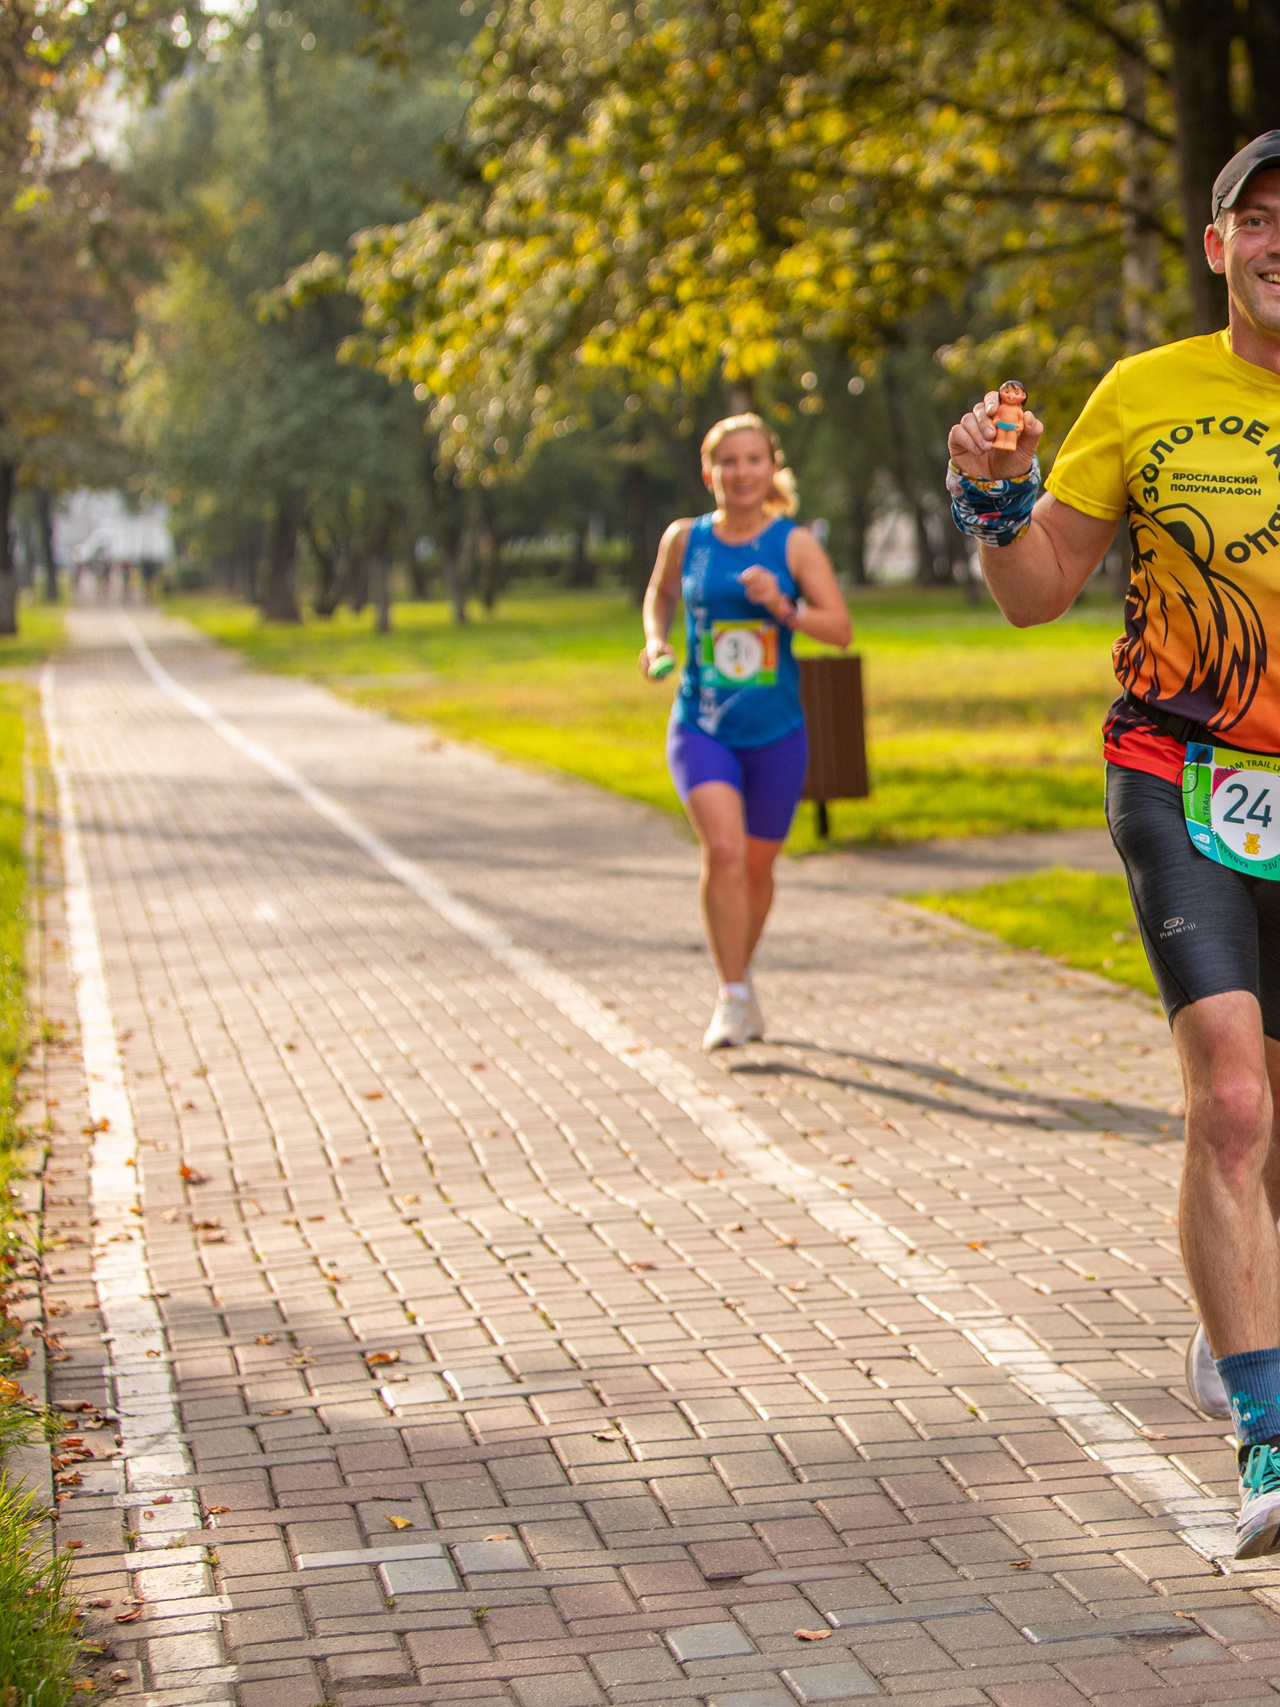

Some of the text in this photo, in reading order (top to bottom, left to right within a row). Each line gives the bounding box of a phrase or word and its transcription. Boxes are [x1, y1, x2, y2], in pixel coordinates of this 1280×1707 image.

[1140, 416, 1270, 504] ЗОЛОТОЕ
[1170, 484, 1262, 496] ПОЛУМАРАФОН
[1172, 473, 1258, 485] ЯРОСЛАВСКИЙ
[1214, 761, 1245, 783] DREAM
[1246, 760, 1271, 769] TRAIL
[1203, 793, 1212, 817] TRAIL
[1220, 843, 1249, 869] KANNAS
[1262, 861, 1278, 872] ЛЕС
